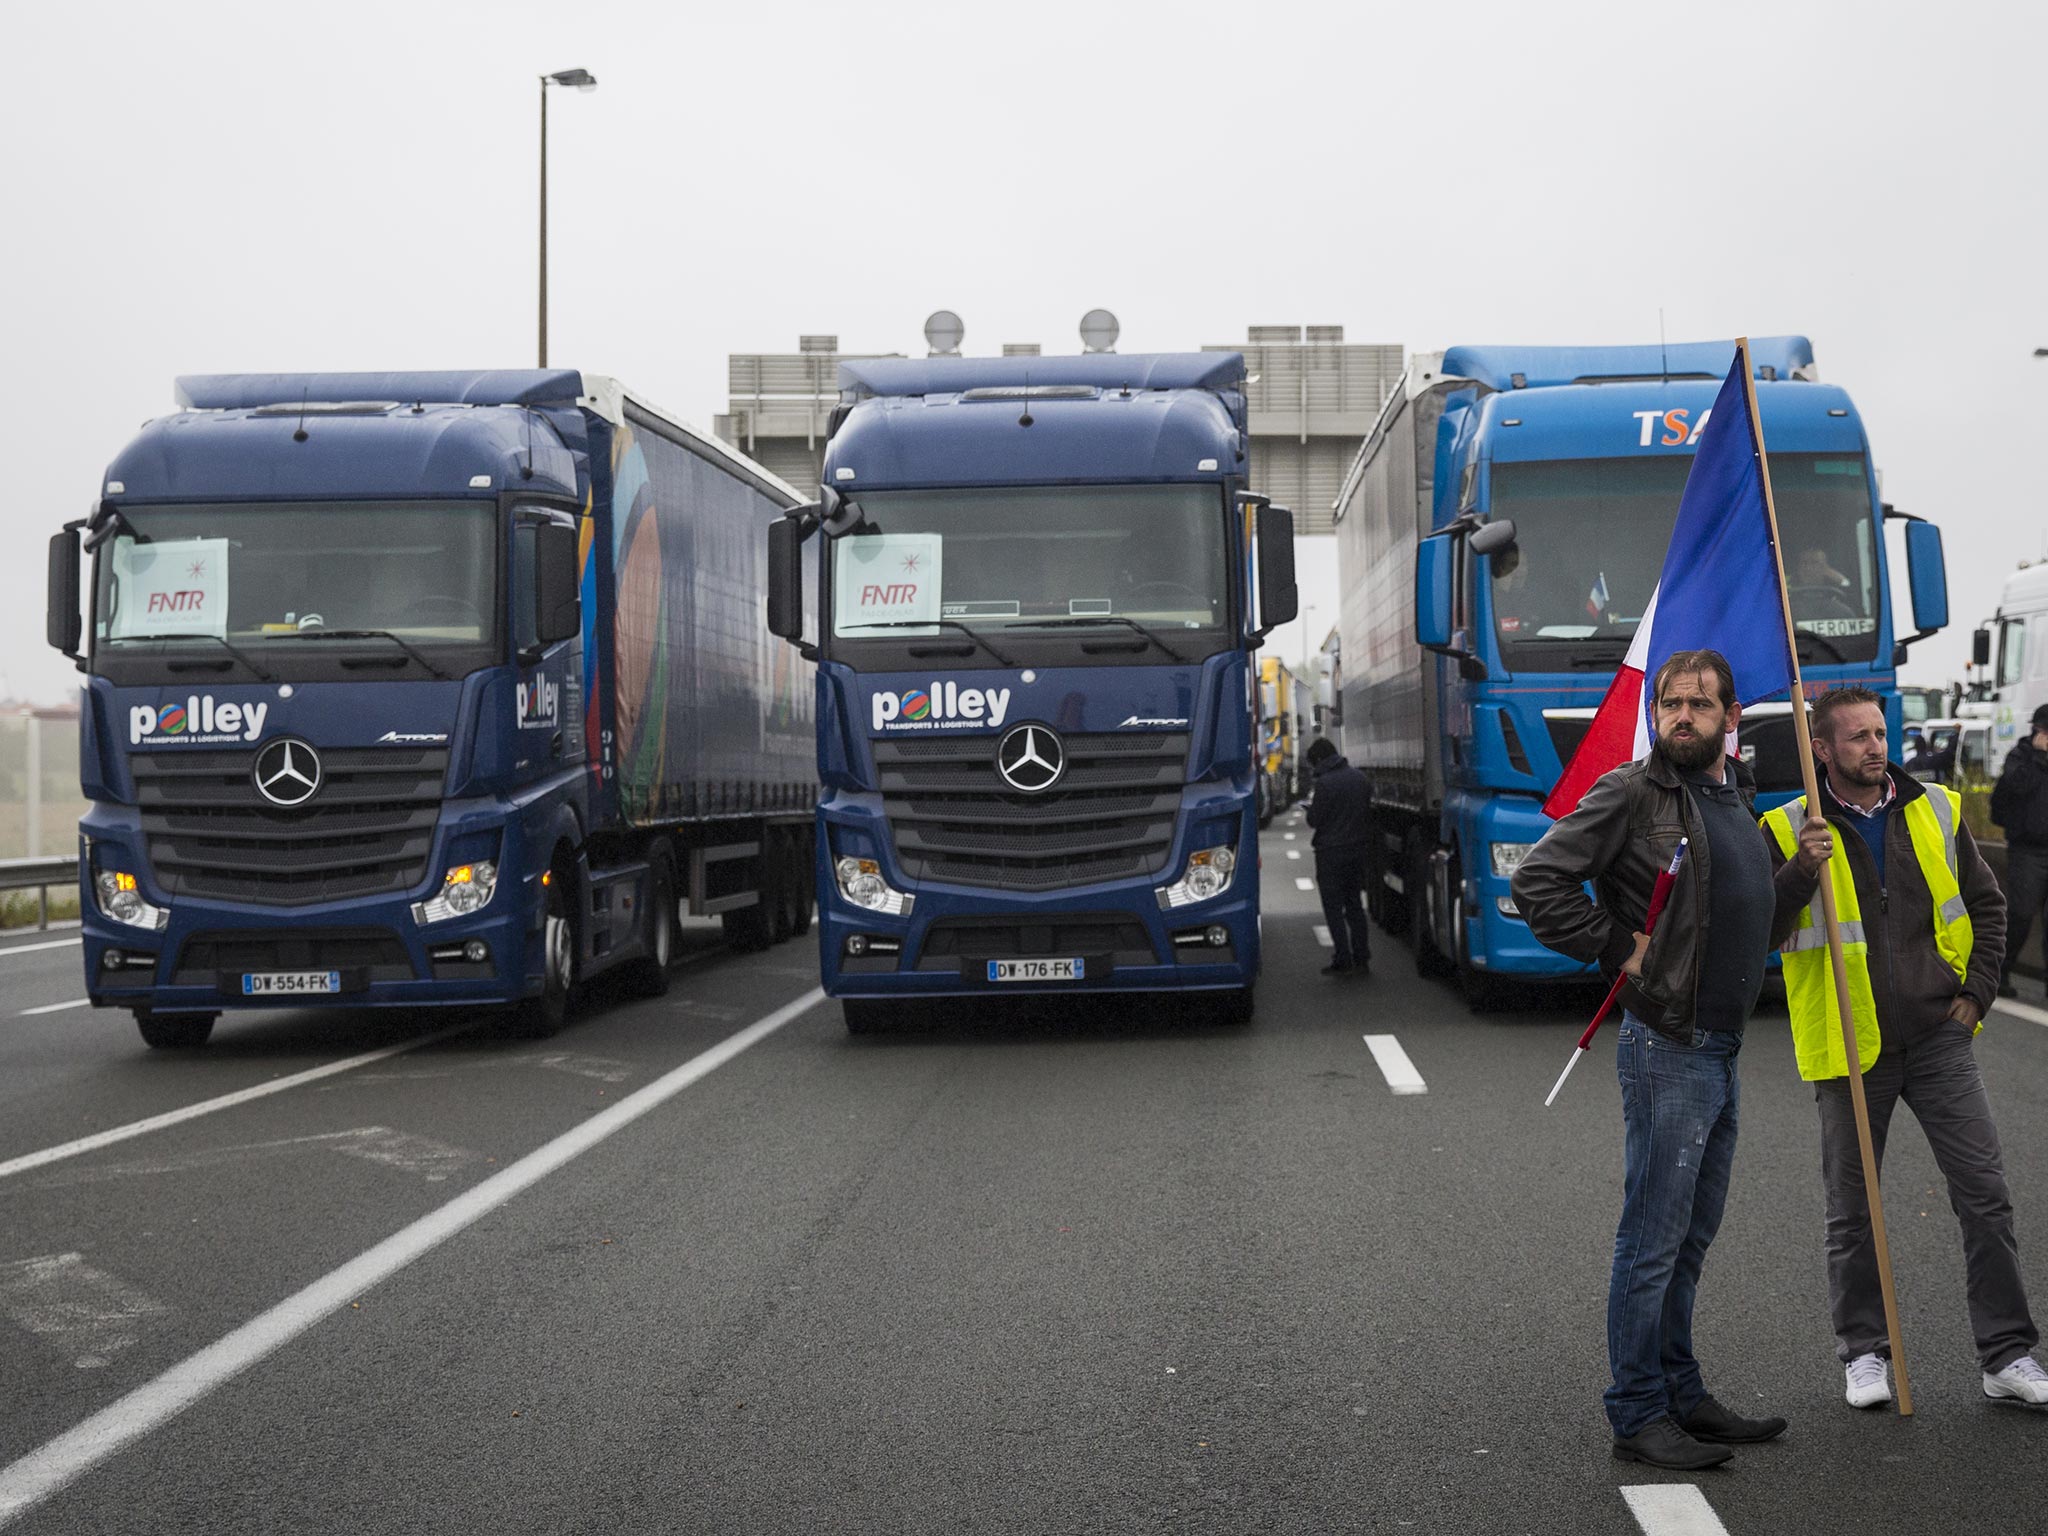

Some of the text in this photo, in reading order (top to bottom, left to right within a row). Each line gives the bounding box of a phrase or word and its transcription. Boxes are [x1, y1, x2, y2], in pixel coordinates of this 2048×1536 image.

[147, 590, 205, 614] FNTR
[861, 584, 917, 606] FNTR
[517, 672, 559, 729] polley
[872, 681, 1010, 730] polley
[130, 695, 268, 745] polley
[885, 722, 932, 730] TRANSPORTS
[941, 720, 984, 729] LOGISTIQUE
[143, 736, 189, 744] TRANSPORTS
[198, 734, 240, 743] LOGISTIQUE
[998, 962, 1073, 977] DW-176-FK
[253, 975, 328, 990] DW-554-FK
